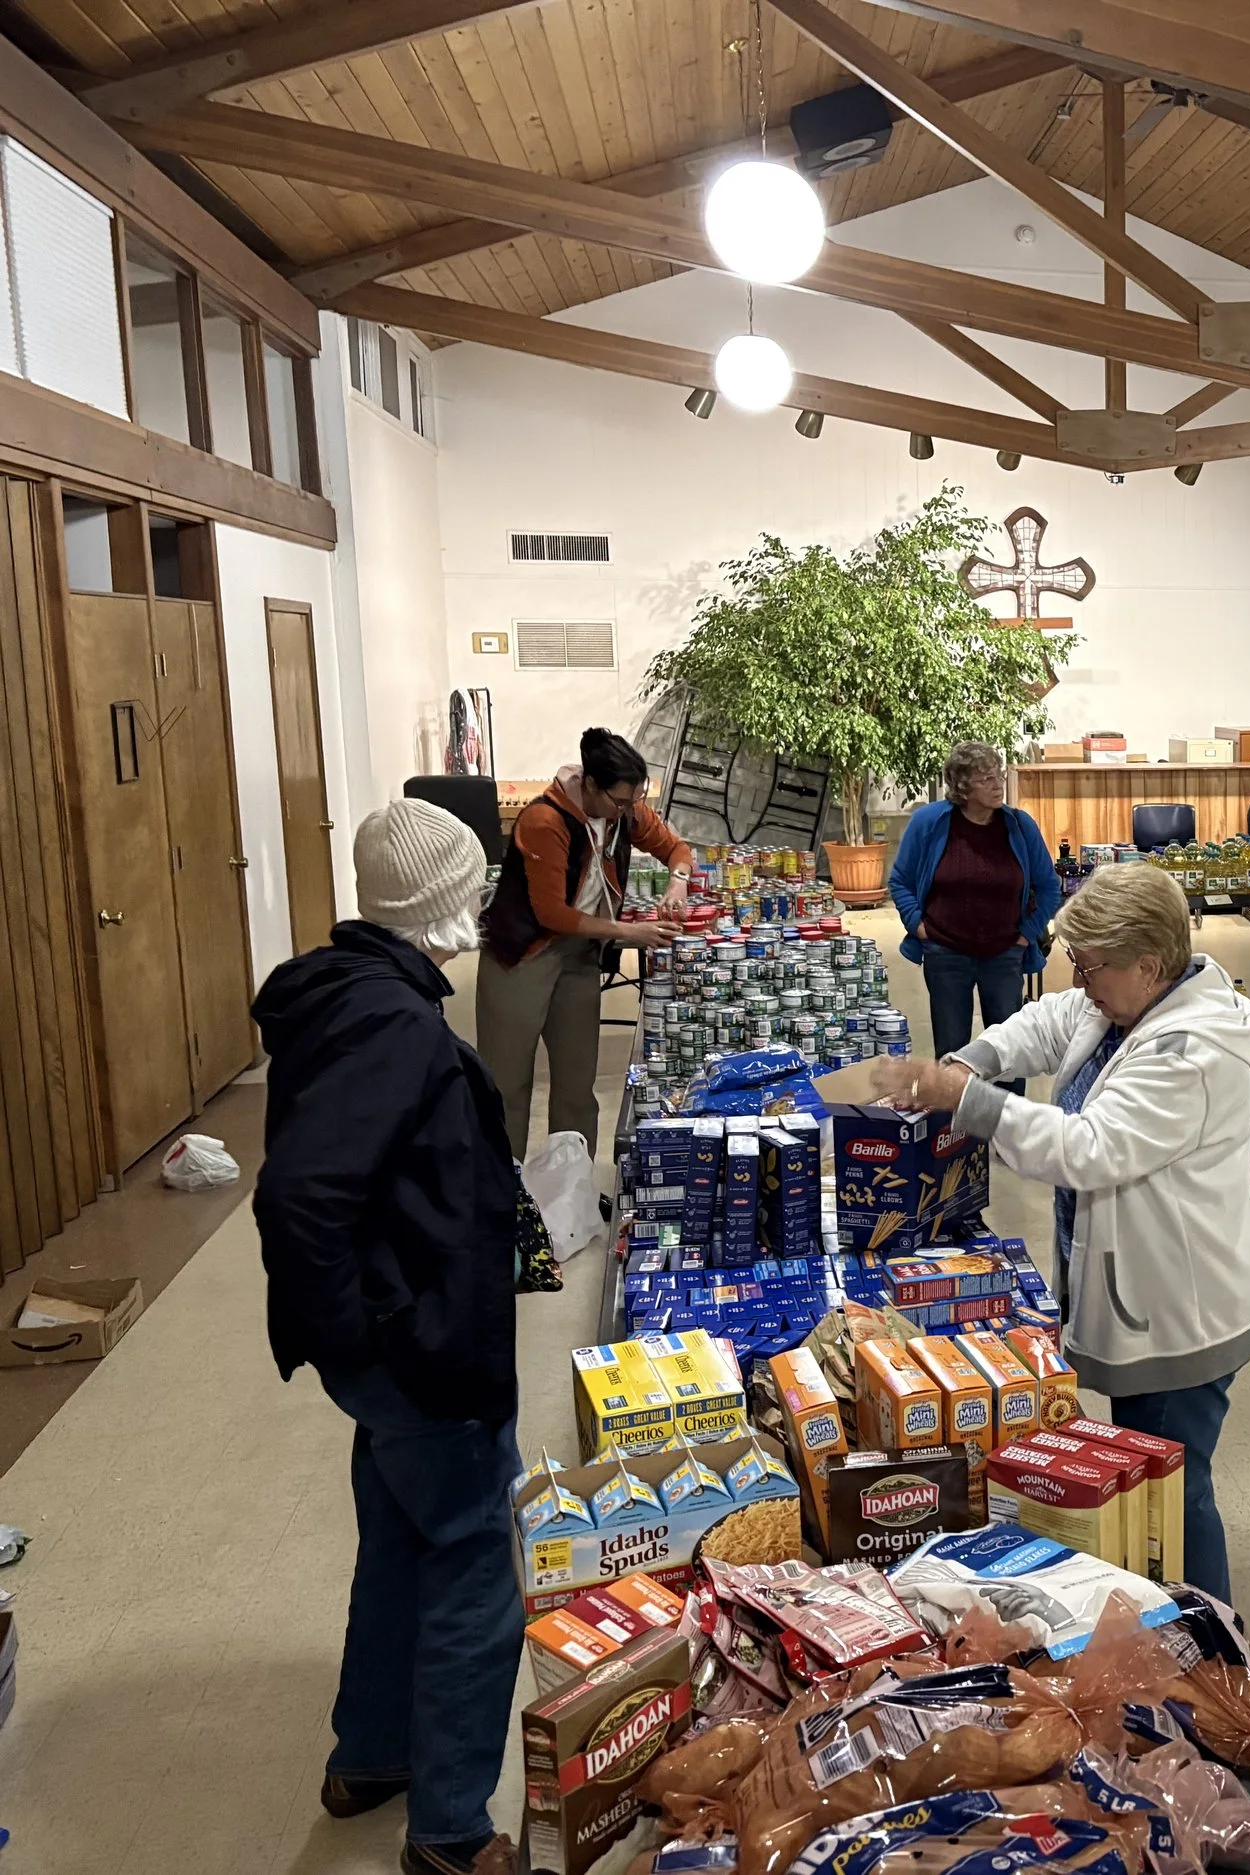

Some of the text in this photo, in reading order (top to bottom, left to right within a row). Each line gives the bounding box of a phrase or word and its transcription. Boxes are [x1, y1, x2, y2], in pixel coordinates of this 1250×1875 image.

[900, 1125, 910, 1140] 6
[852, 1143, 894, 1158] Barilla
[840, 1217, 871, 1226] SPAGHETTI
[706, 1399, 721, 1410] GREAT
[723, 1396, 737, 1408] VALUE
[1006, 1398, 1030, 1411] Mini
[634, 1412, 650, 1425] GREAT
[650, 1409, 666, 1422] VALUE
[908, 1409, 935, 1422] Mini
[958, 1406, 985, 1418] Mini
[1004, 1406, 1032, 1421] Wheats
[684, 1412, 736, 1432] Cheerios
[906, 1418, 936, 1433] Wheats
[957, 1413, 987, 1429] Wheats
[1076, 1419, 1124, 1435] POTATOES
[612, 1426, 664, 1444] Cheerios
[806, 1422, 834, 1439] Mini
[1068, 1423, 1117, 1439] MASHED
[806, 1431, 837, 1447] Wheats
[1030, 1437, 1080, 1453] MASHED
[1038, 1432, 1086, 1448] POTATOES
[903, 1445, 949, 1456] Original
[1006, 1446, 1056, 1462] POTATOES
[1000, 1451, 1051, 1467] MASHED
[1017, 1474, 1066, 1497] MOUNTAIN
[866, 1489, 934, 1514] IDAHOAN
[1024, 1487, 1059, 1503] HARVEST
[535, 1544, 549, 1553] 56
[600, 1524, 669, 1557] Idaho
[600, 1542, 669, 1577] Spuds
[843, 1555, 892, 1564] MASHED
[652, 1570, 685, 1584] tatoes
[586, 1693, 672, 1779] IDAHOAN
[577, 1799, 631, 1845] MASHED
